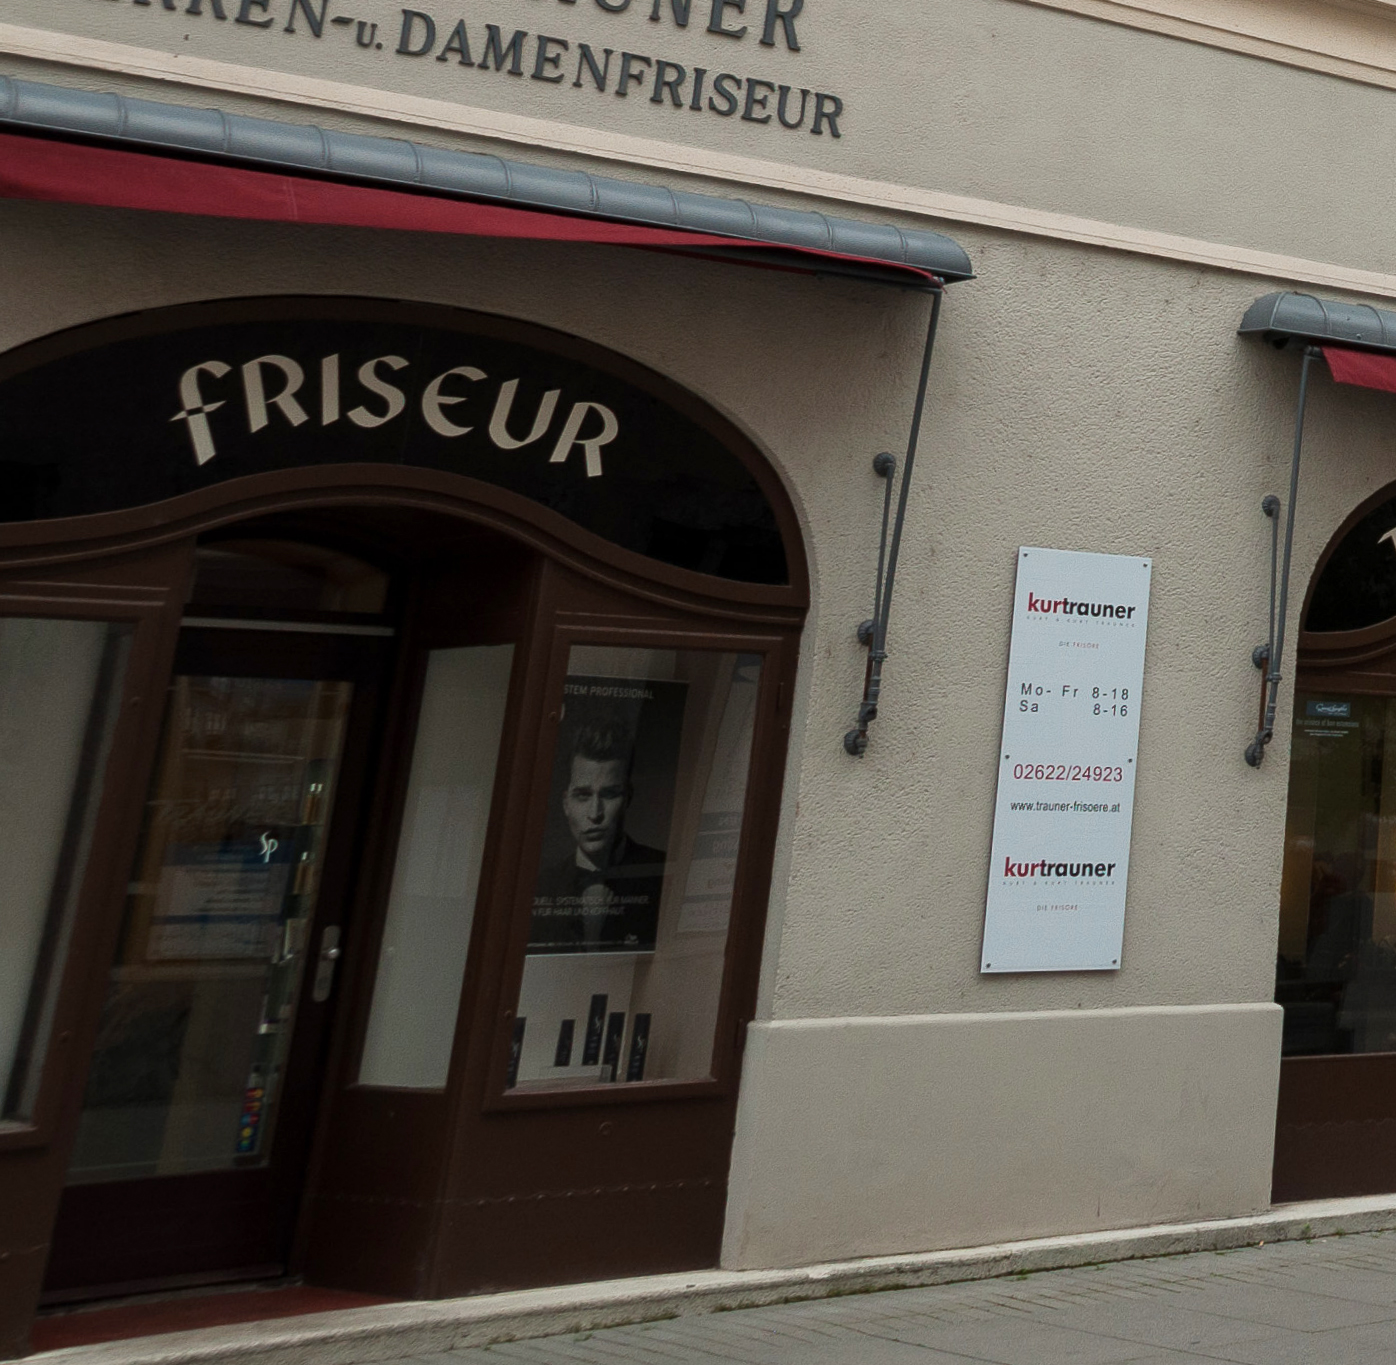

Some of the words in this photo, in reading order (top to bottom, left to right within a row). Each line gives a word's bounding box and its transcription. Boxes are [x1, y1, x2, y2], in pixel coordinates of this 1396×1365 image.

[395, 9, 845, 139] DAMENFRISEUR
[169, 353, 621, 479] FRISEUR
[589, 685, 655, 700] PROFESSIONAL
[1061, 684, 1079, 698] Fr
[1019, 699, 1039, 713] Sa
[1013, 763, 1124, 782] 02622/24923
[1010, 800, 1121, 813] www.trauner-frisoere.at
